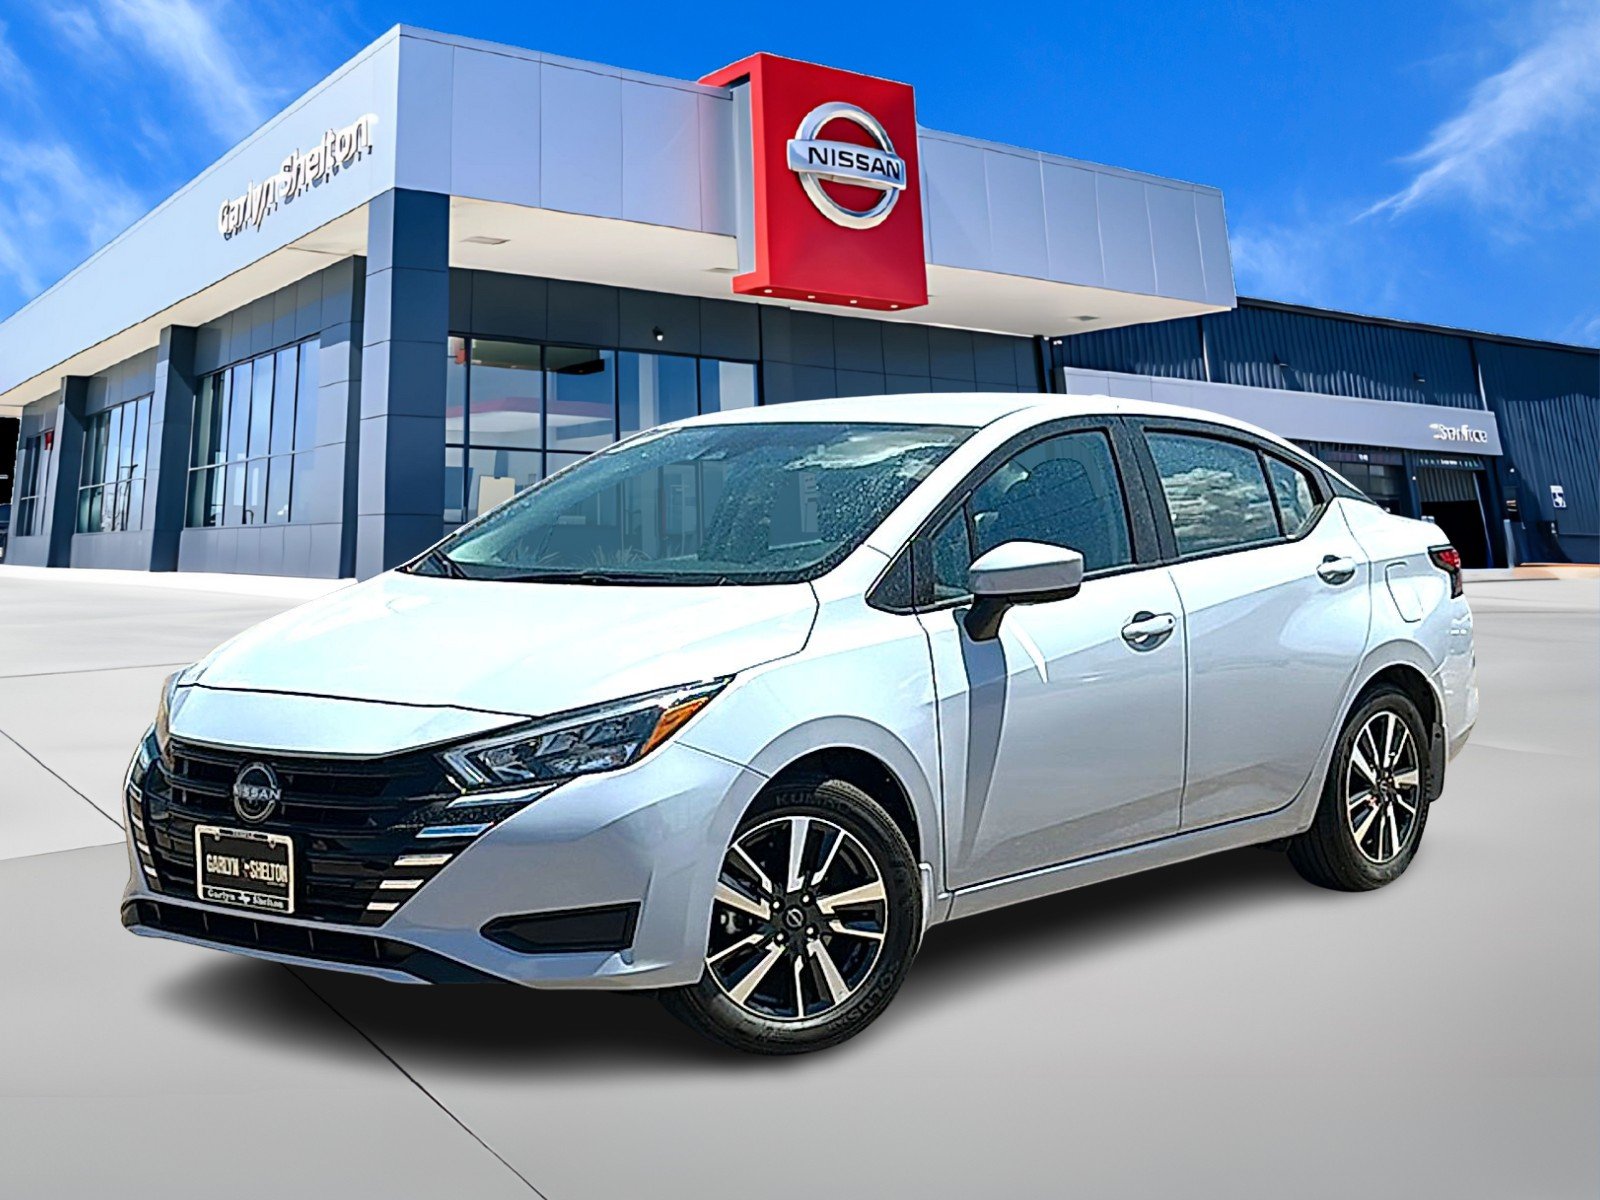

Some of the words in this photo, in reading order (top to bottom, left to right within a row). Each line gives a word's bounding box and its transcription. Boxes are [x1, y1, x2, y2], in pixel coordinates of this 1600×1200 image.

[218, 178, 278, 240] Garlyn
[280, 114, 374, 204] Shelton
[808, 147, 900, 180] NISSAN
[249, 860, 288, 883] SHELTON
